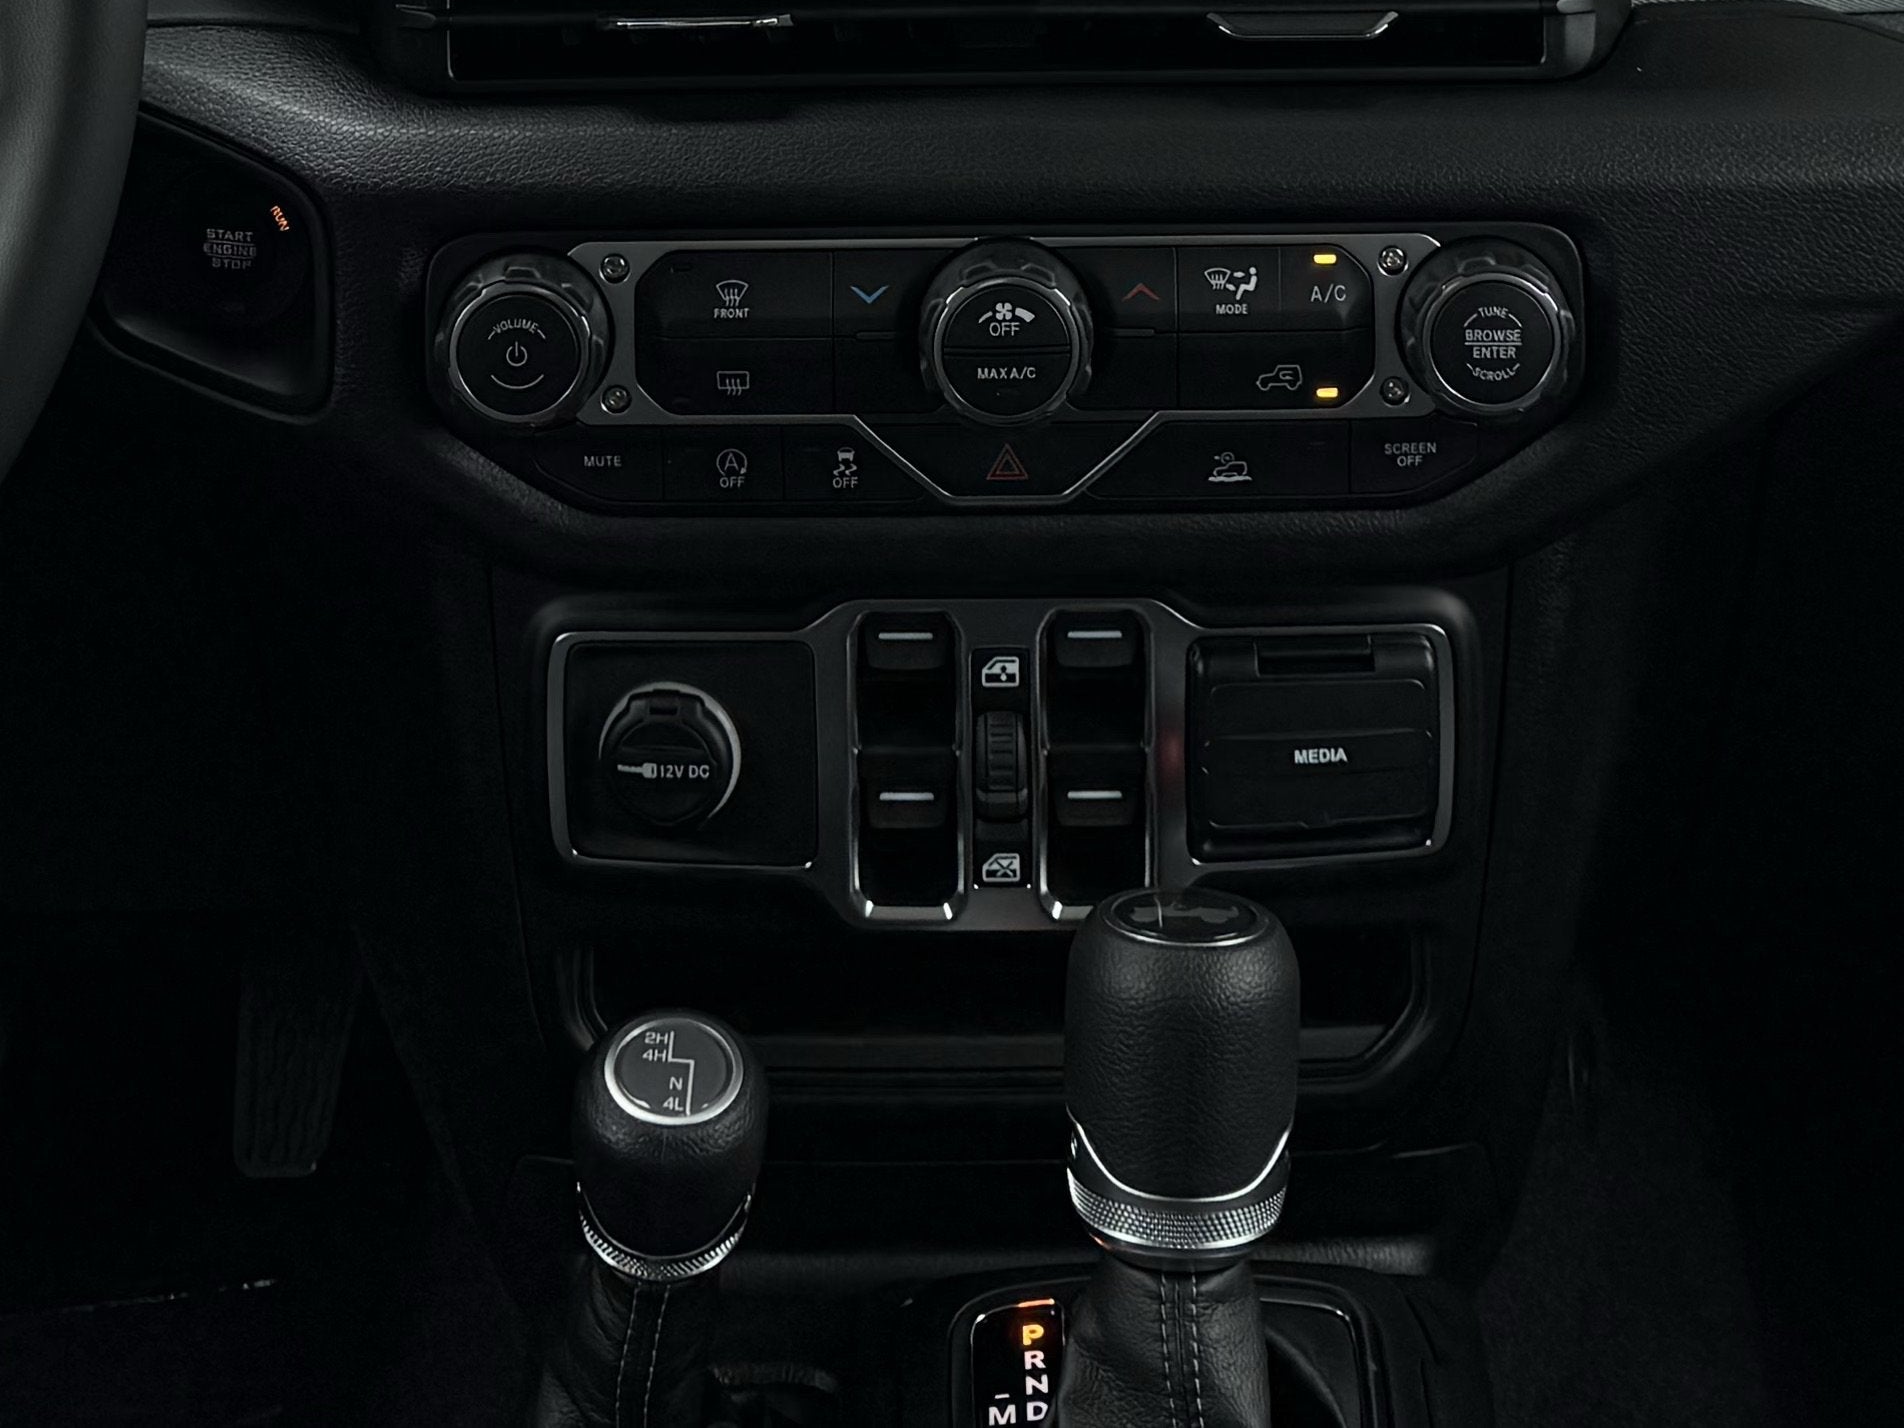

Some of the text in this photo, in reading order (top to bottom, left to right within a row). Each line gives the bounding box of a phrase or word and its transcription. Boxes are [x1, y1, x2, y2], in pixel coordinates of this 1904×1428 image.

[270, 205, 289, 231] RUN
[207, 229, 253, 241] START
[203, 243, 257, 256] ENGINE
[1310, 286, 1346, 303] A/C
[713, 307, 750, 319] FRONT
[1216, 304, 1248, 315] MODE
[1478, 306, 1509, 319] TUNE
[493, 319, 539, 335] VOLUME
[989, 322, 1020, 336] OFF
[1465, 330, 1521, 342] BROWSE
[1472, 347, 1516, 359] ENTER
[977, 367, 1036, 380] MAX A/C
[1472, 367, 1514, 381] SCROLL
[1384, 443, 1436, 454] SCREEN
[583, 455, 622, 468] MUTE
[1397, 455, 1422, 466] OFF
[719, 477, 746, 489] OFF
[833, 476, 858, 489] OFF
[1294, 748, 1348, 764] MEDIA
[661, 765, 710, 779] 12V DC
[645, 1032, 668, 1044] 2H
[642, 1049, 667, 1062] 4H
[669, 1077, 683, 1090] N
[663, 1097, 684, 1111] 4L
[1023, 1324, 1044, 1345] P
[1024, 1350, 1046, 1370] R
[1026, 1374, 1048, 1395] N
[989, 1404, 1016, 1426] M
[1027, 1401, 1048, 1421] D
